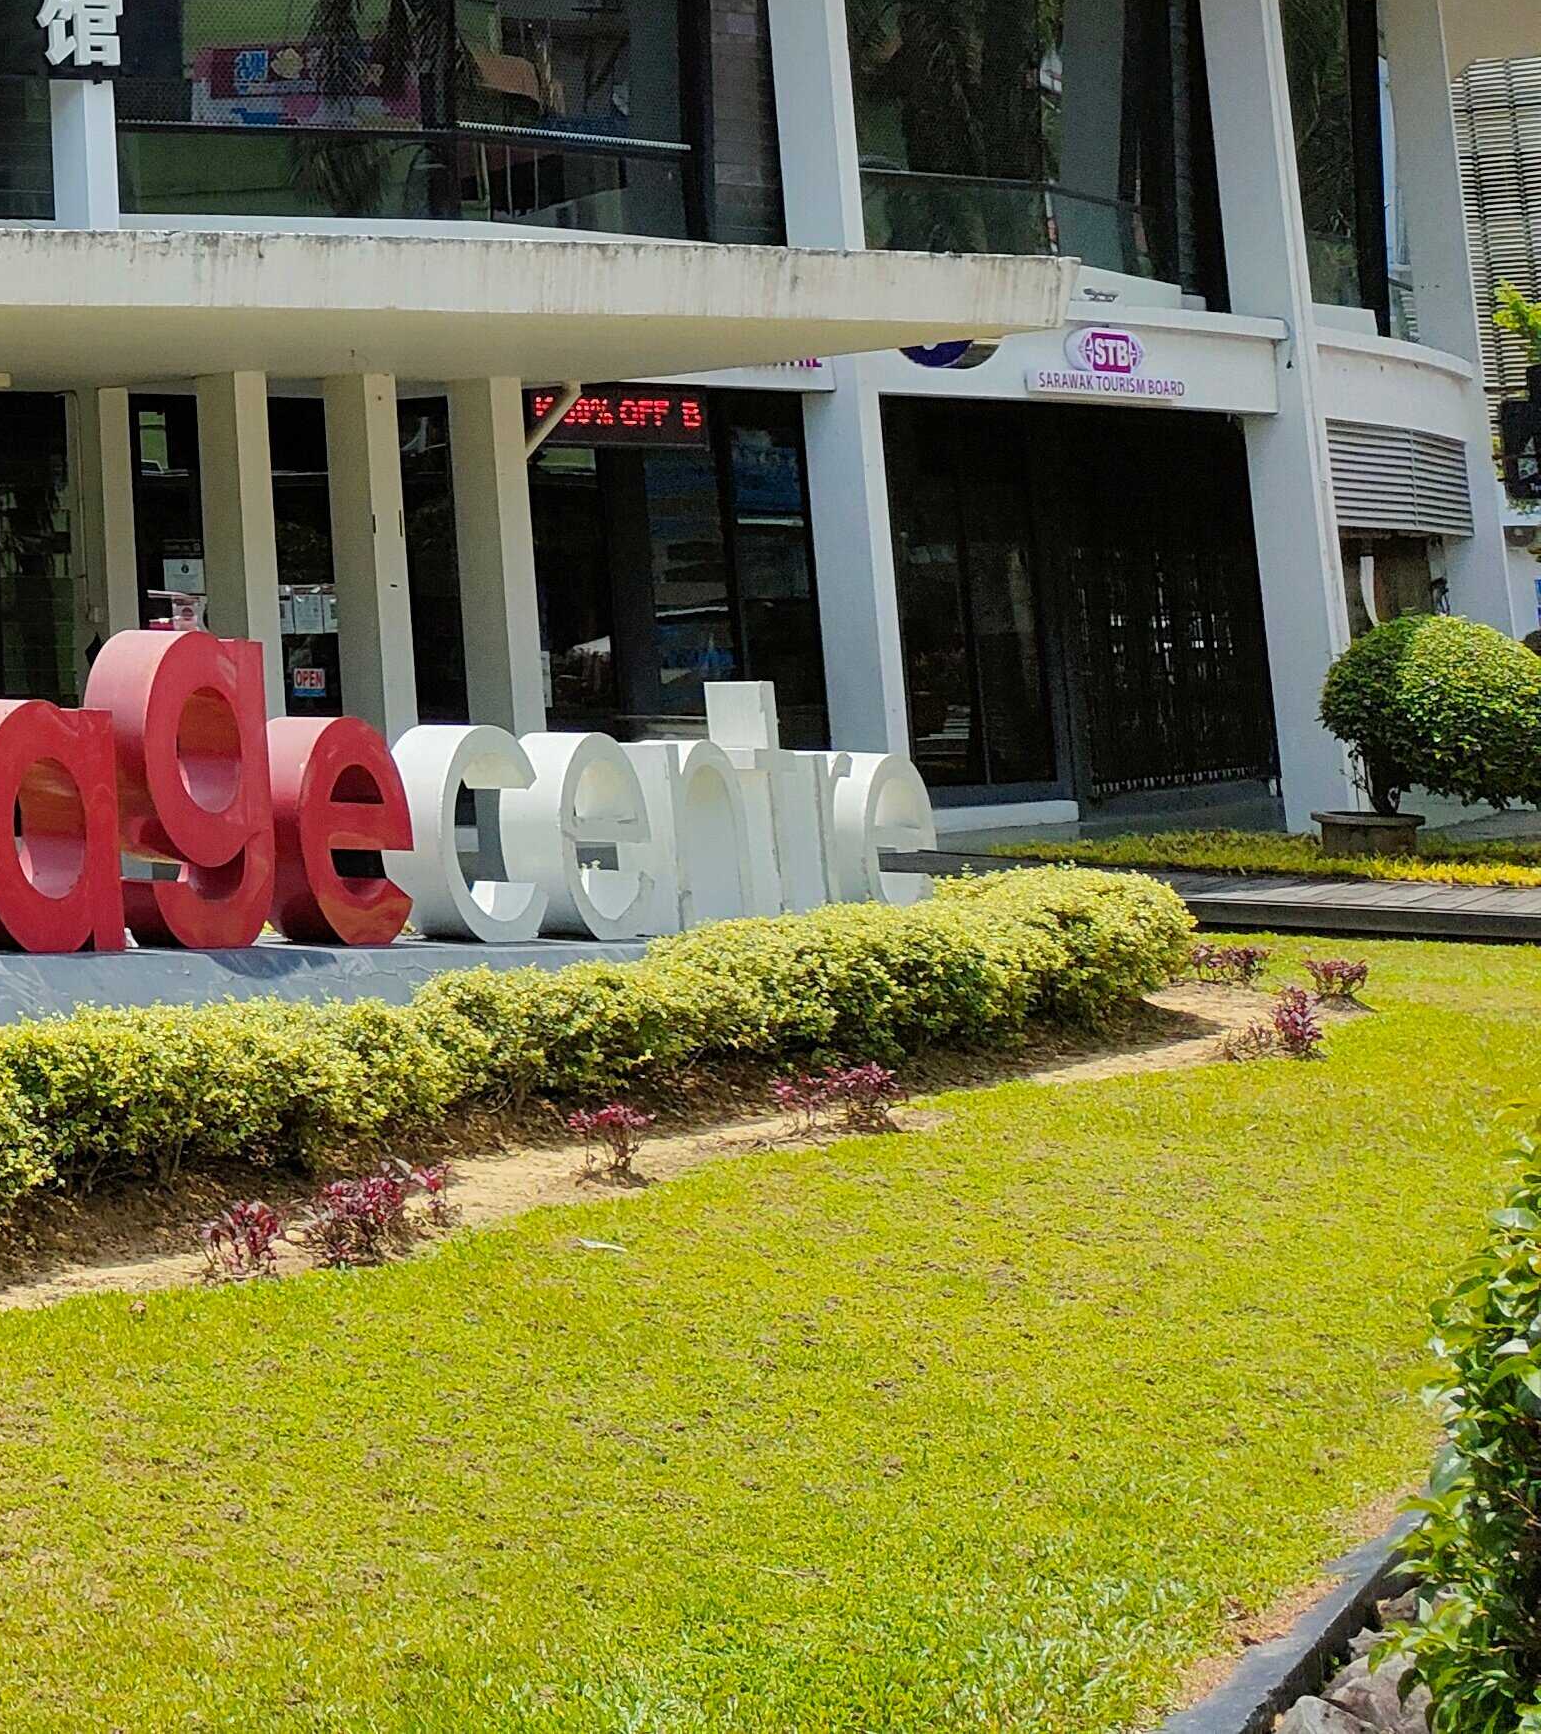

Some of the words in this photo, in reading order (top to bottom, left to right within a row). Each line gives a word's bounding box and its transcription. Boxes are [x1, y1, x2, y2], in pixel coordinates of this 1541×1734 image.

[1094, 337, 1130, 367] STB
[1038, 371, 1094, 392] SARAWAK
[1095, 375, 1147, 395] TOURISM
[1147, 379, 1185, 397] BOARD
[618, 398, 671, 427] OFF
[296, 670, 323, 687] OPEN
